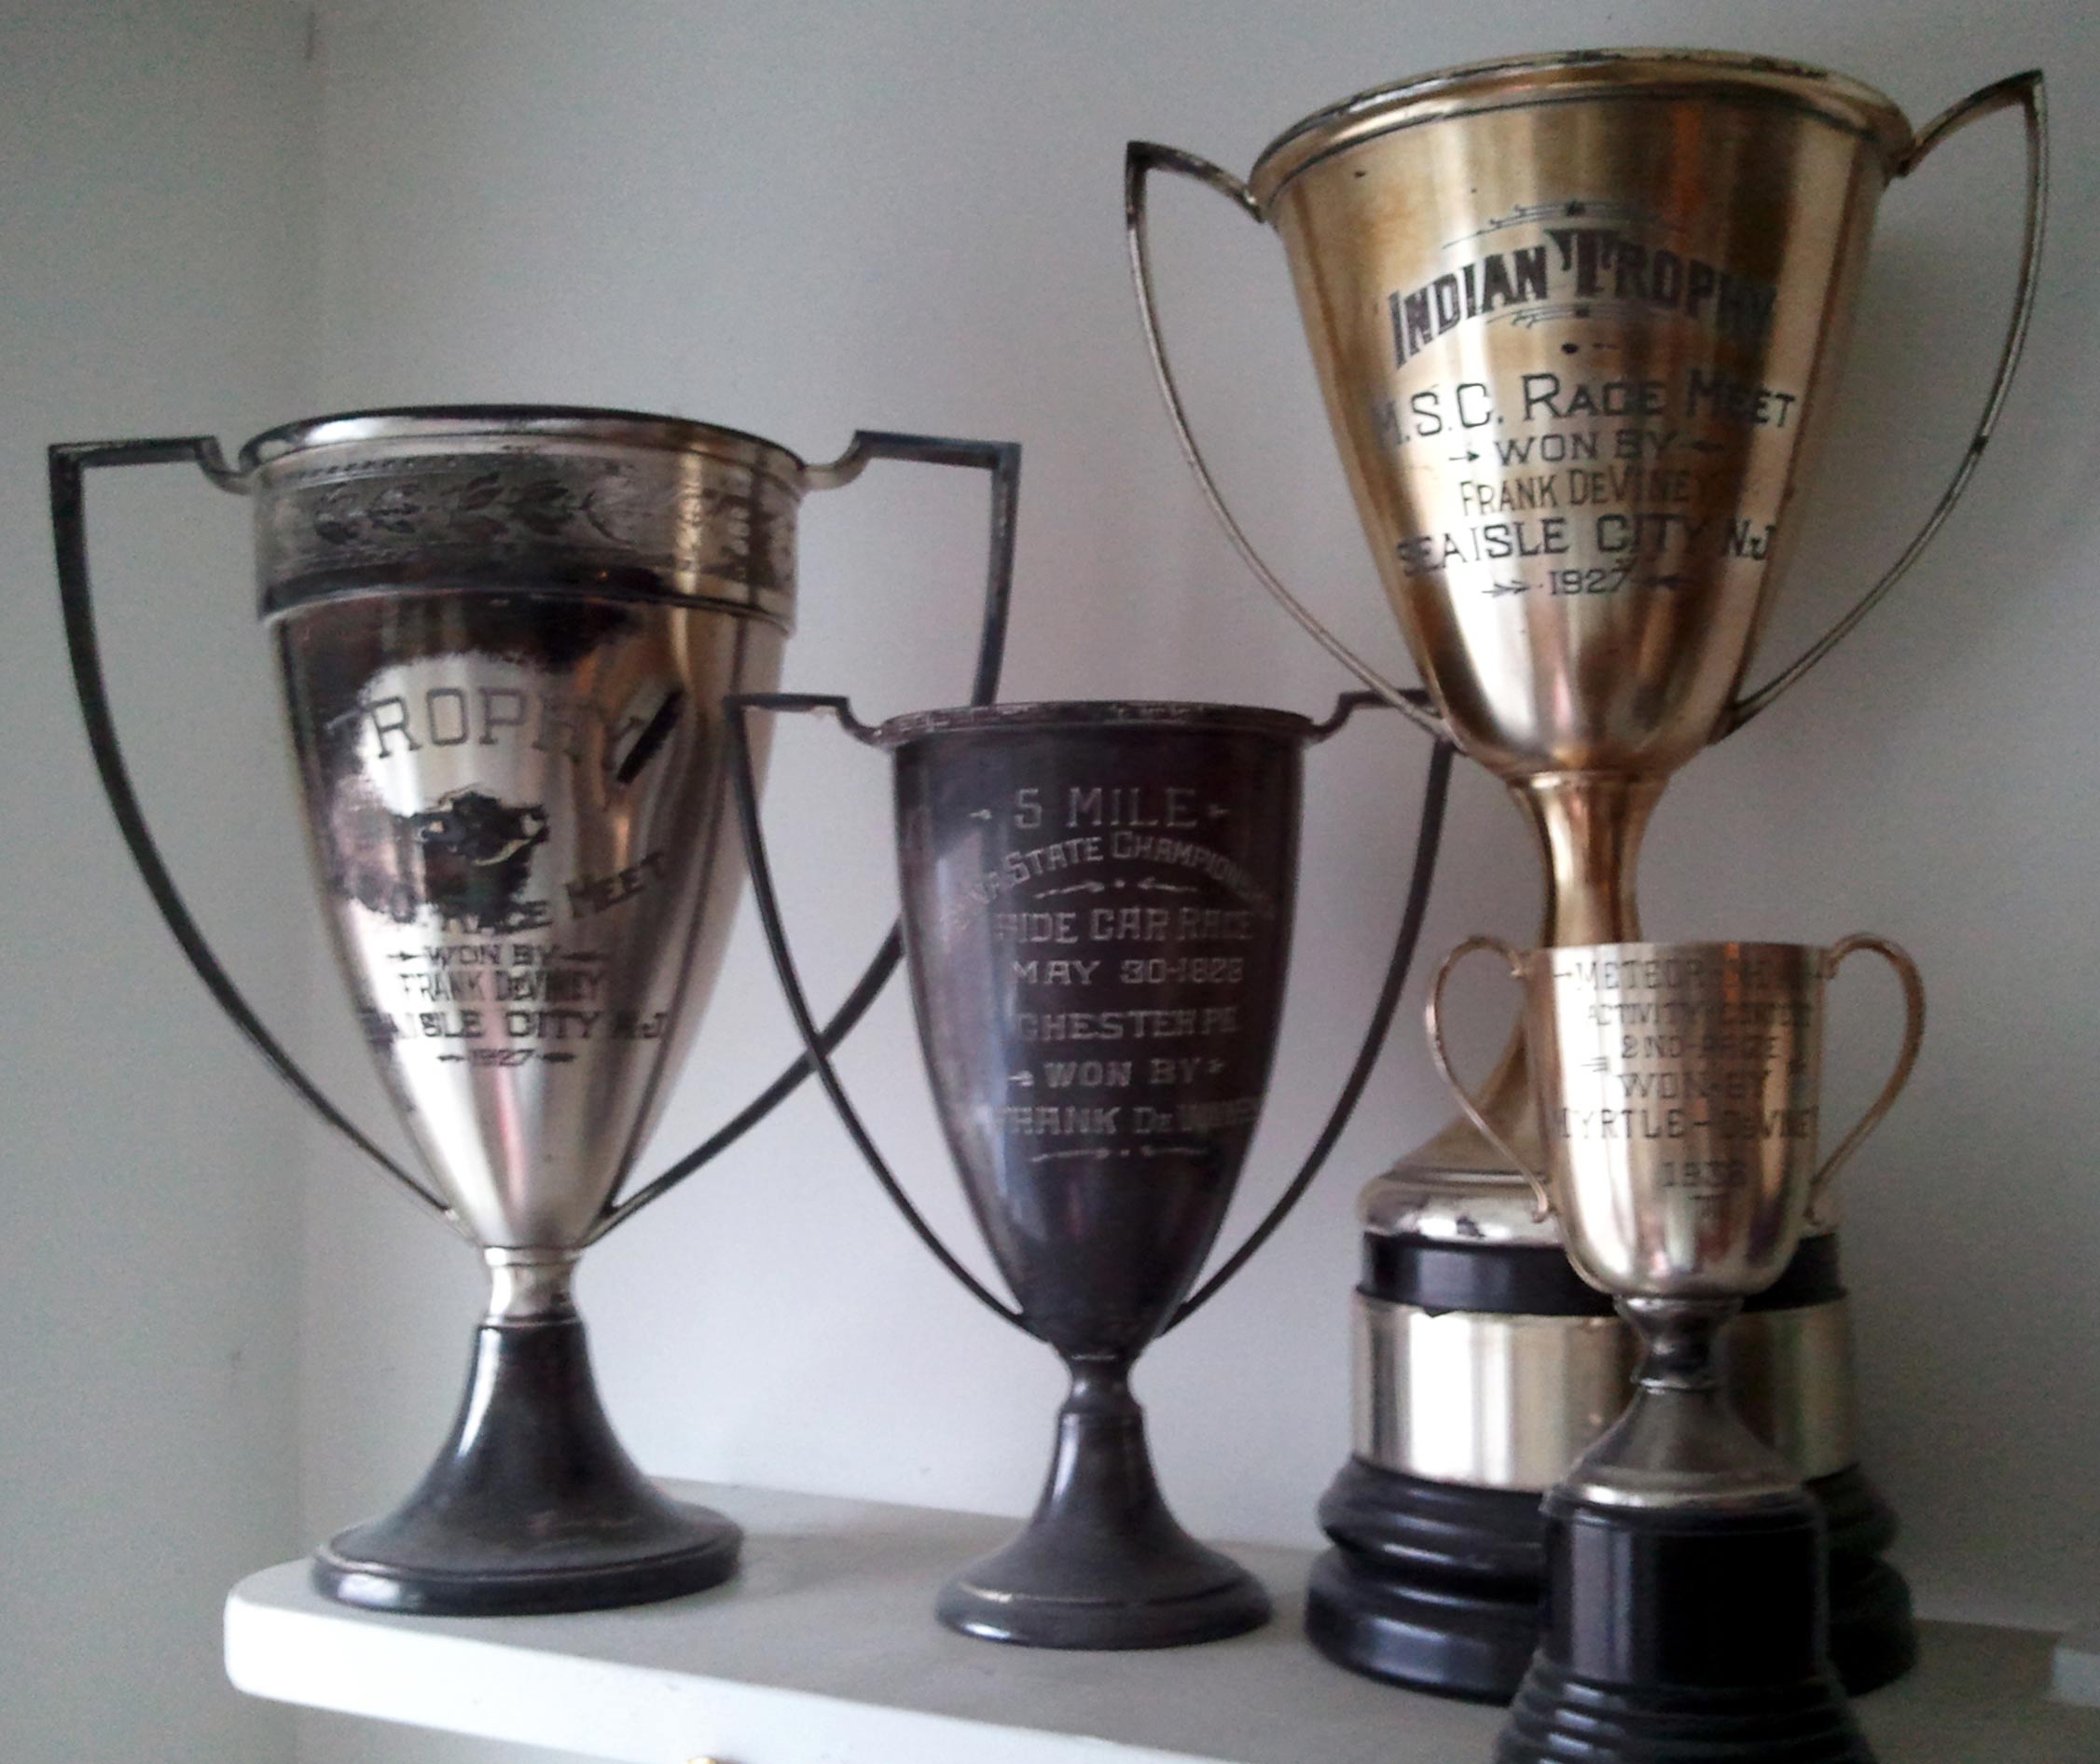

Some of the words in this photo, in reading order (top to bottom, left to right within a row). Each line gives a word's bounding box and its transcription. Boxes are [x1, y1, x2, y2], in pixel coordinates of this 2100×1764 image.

[1388, 244, 1548, 369] INDIAN
[1522, 373, 1667, 421] RACE
[1495, 432, 1597, 467] WON
[1614, 429, 1679, 461] BY
[1460, 477, 1559, 517] FRANK
[1596, 513, 1706, 556] CITY
[1551, 559, 1634, 597] 1927
[1014, 787, 1043, 830] 5
[1066, 786, 1198, 828] MILE
[1005, 835, 1104, 888] STATE
[1088, 906, 1169, 943] CAR
[1178, 905, 1255, 942] RACE
[422, 944, 502, 968] WON
[1010, 958, 1102, 985] MAY
[504, 1009, 604, 1040] CITY
[1015, 1007, 1197, 1042] CHESTER
[1042, 1059, 1134, 1088] WON
[1149, 1056, 1203, 1086] BY
